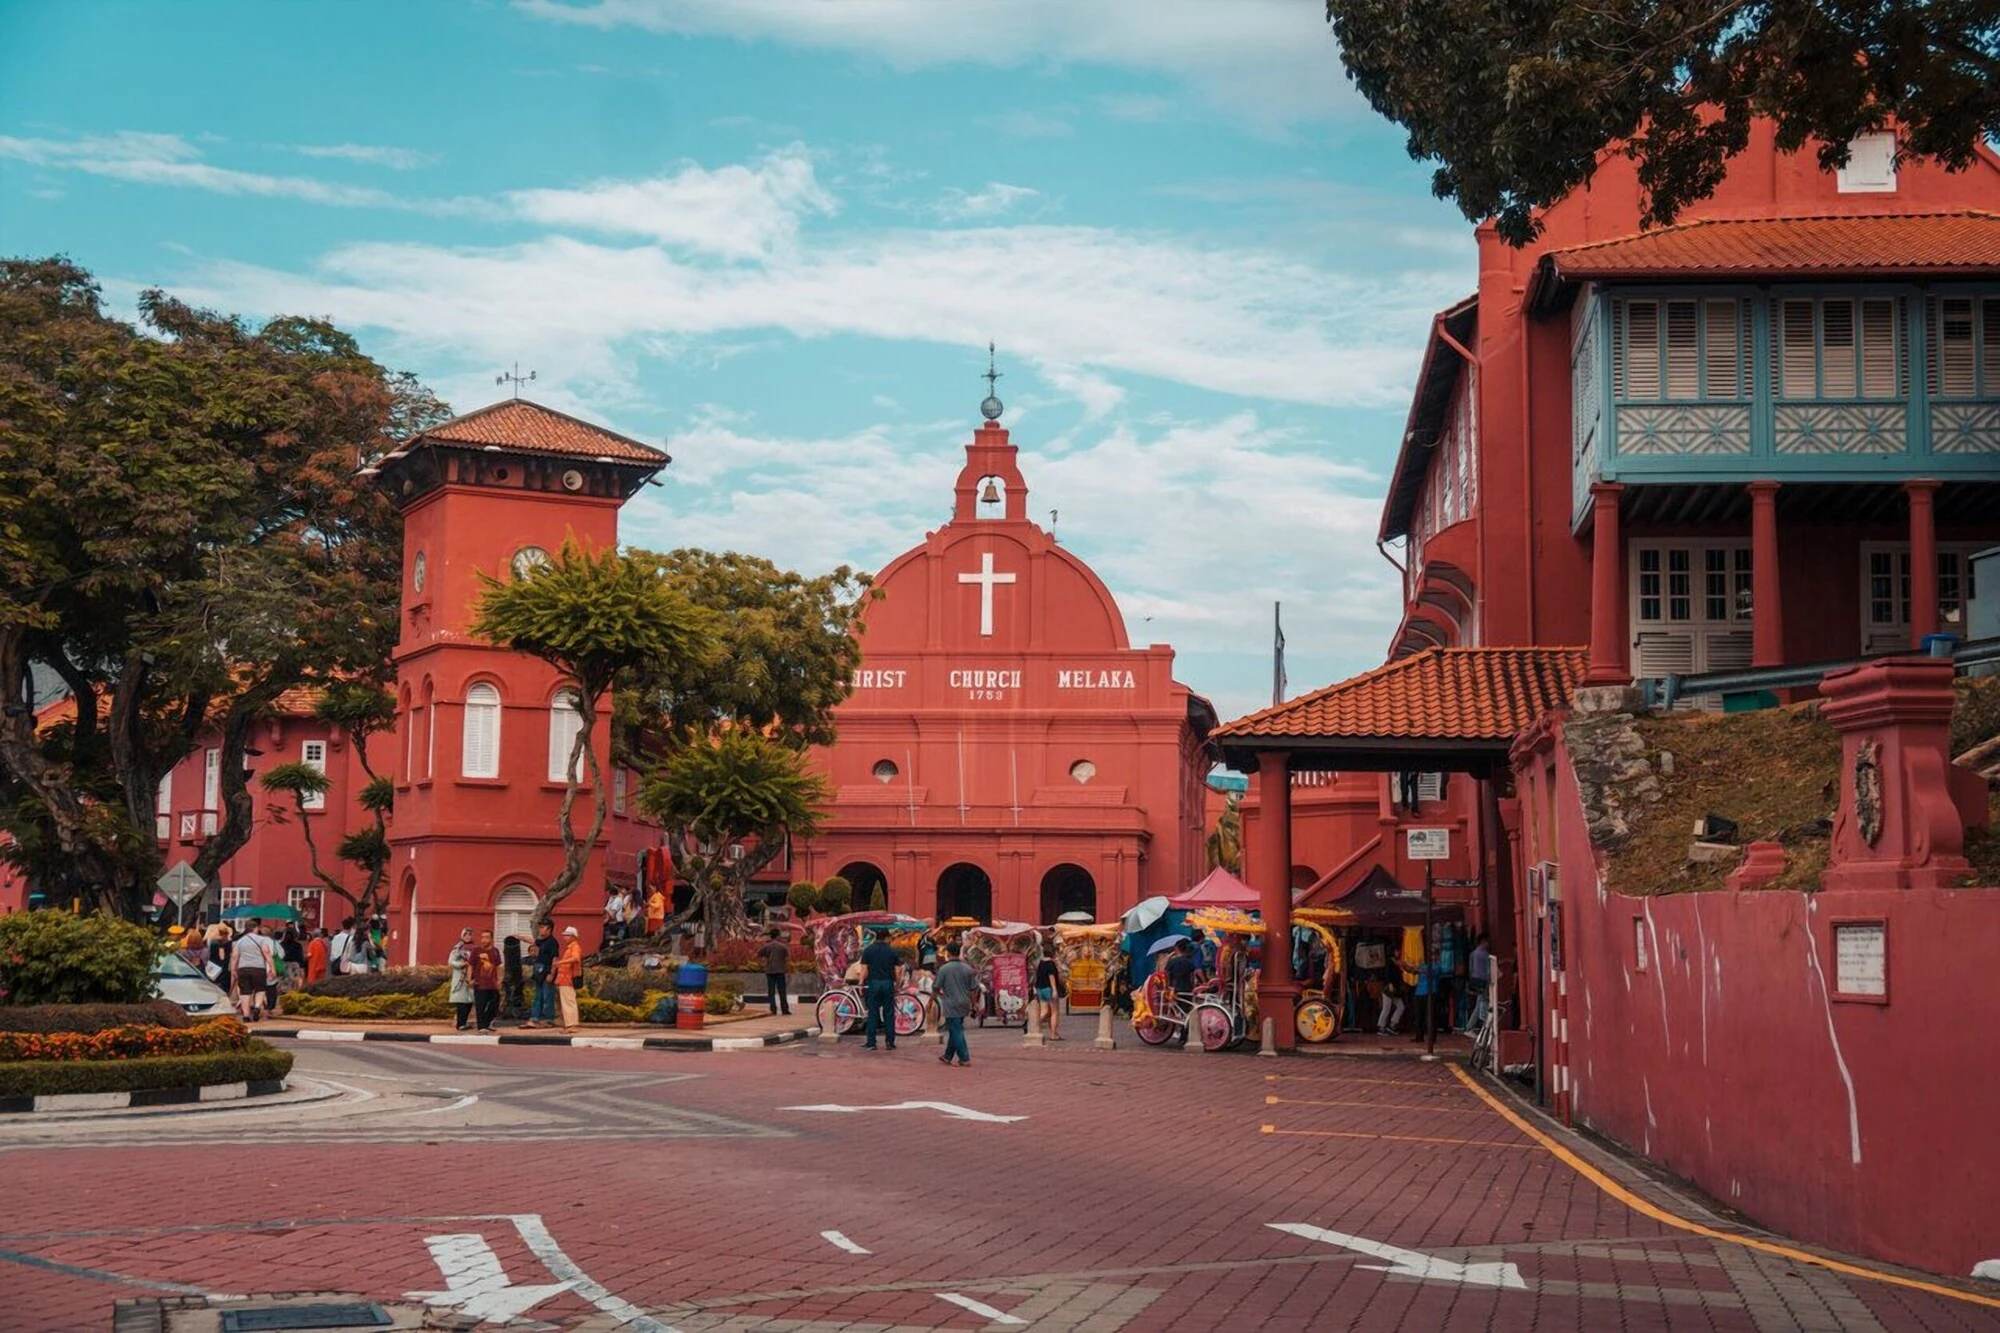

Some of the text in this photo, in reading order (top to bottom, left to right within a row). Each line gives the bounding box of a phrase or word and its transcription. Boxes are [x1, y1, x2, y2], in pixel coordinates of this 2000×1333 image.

[838, 669, 1136, 689] HRIST CHURCH MELAKA
